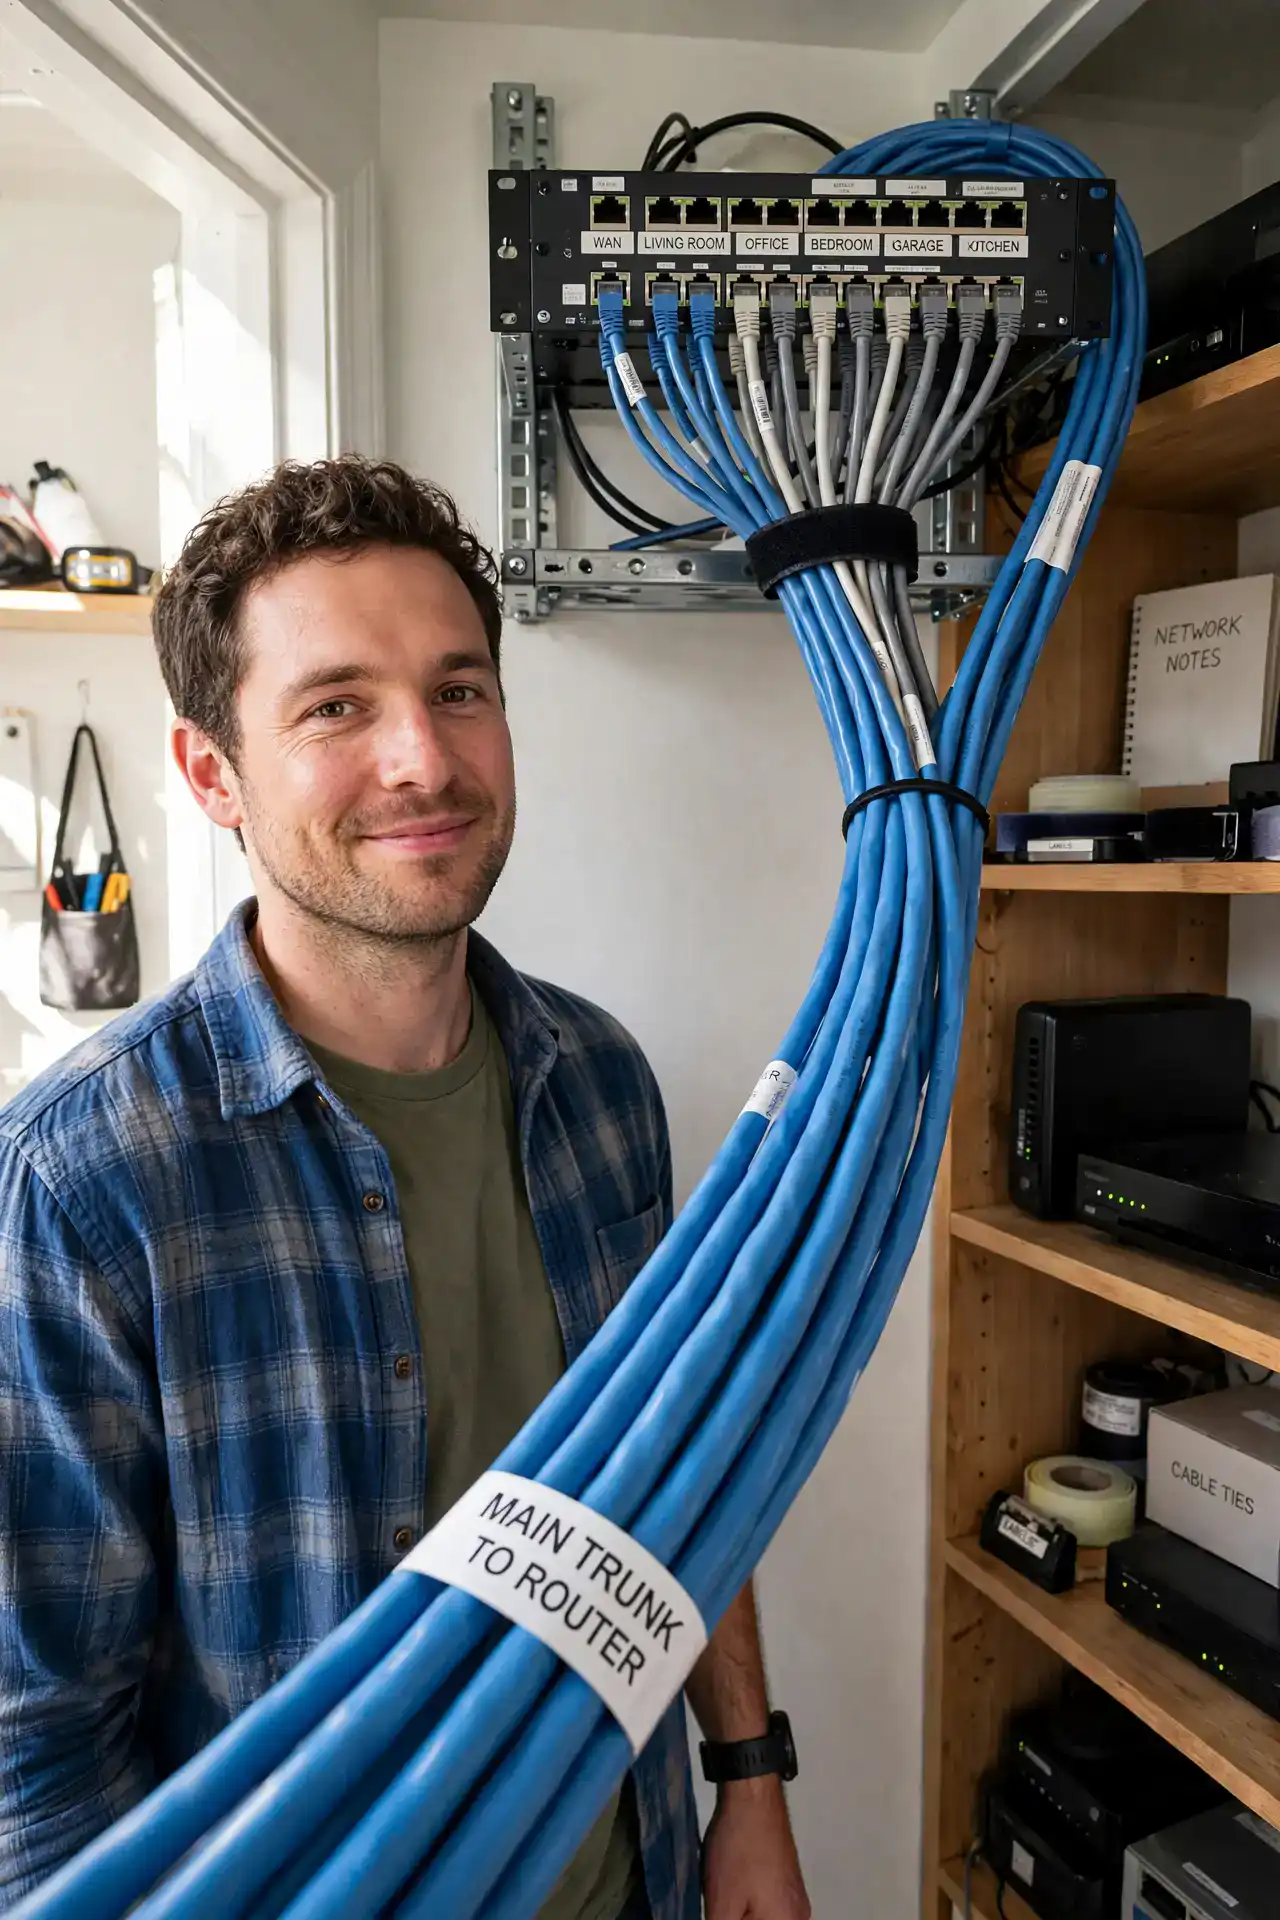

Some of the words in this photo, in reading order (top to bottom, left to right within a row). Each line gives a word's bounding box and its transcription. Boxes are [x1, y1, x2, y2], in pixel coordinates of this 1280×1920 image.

[593, 237, 622, 249] WAN
[644, 237, 685, 250] LIVING
[687, 237, 726, 250] ROOM
[745, 238, 790, 251] OFFICE
[811, 239, 874, 251] BEDROOM
[892, 240, 944, 252] GARAGE
[967, 241, 1020, 253] KITCHEN
[1154, 615, 1242, 646] NETWORK
[1165, 647, 1222, 673] NOTES
[1171, 1460, 1218, 1497] CABLE
[1221, 1484, 1255, 1516] TIES
[480, 1492, 576, 1554] MAIN
[575, 1536, 685, 1653] TRUNK
[468, 1535, 514, 1575] TO
[514, 1561, 647, 1687] ROUTER
